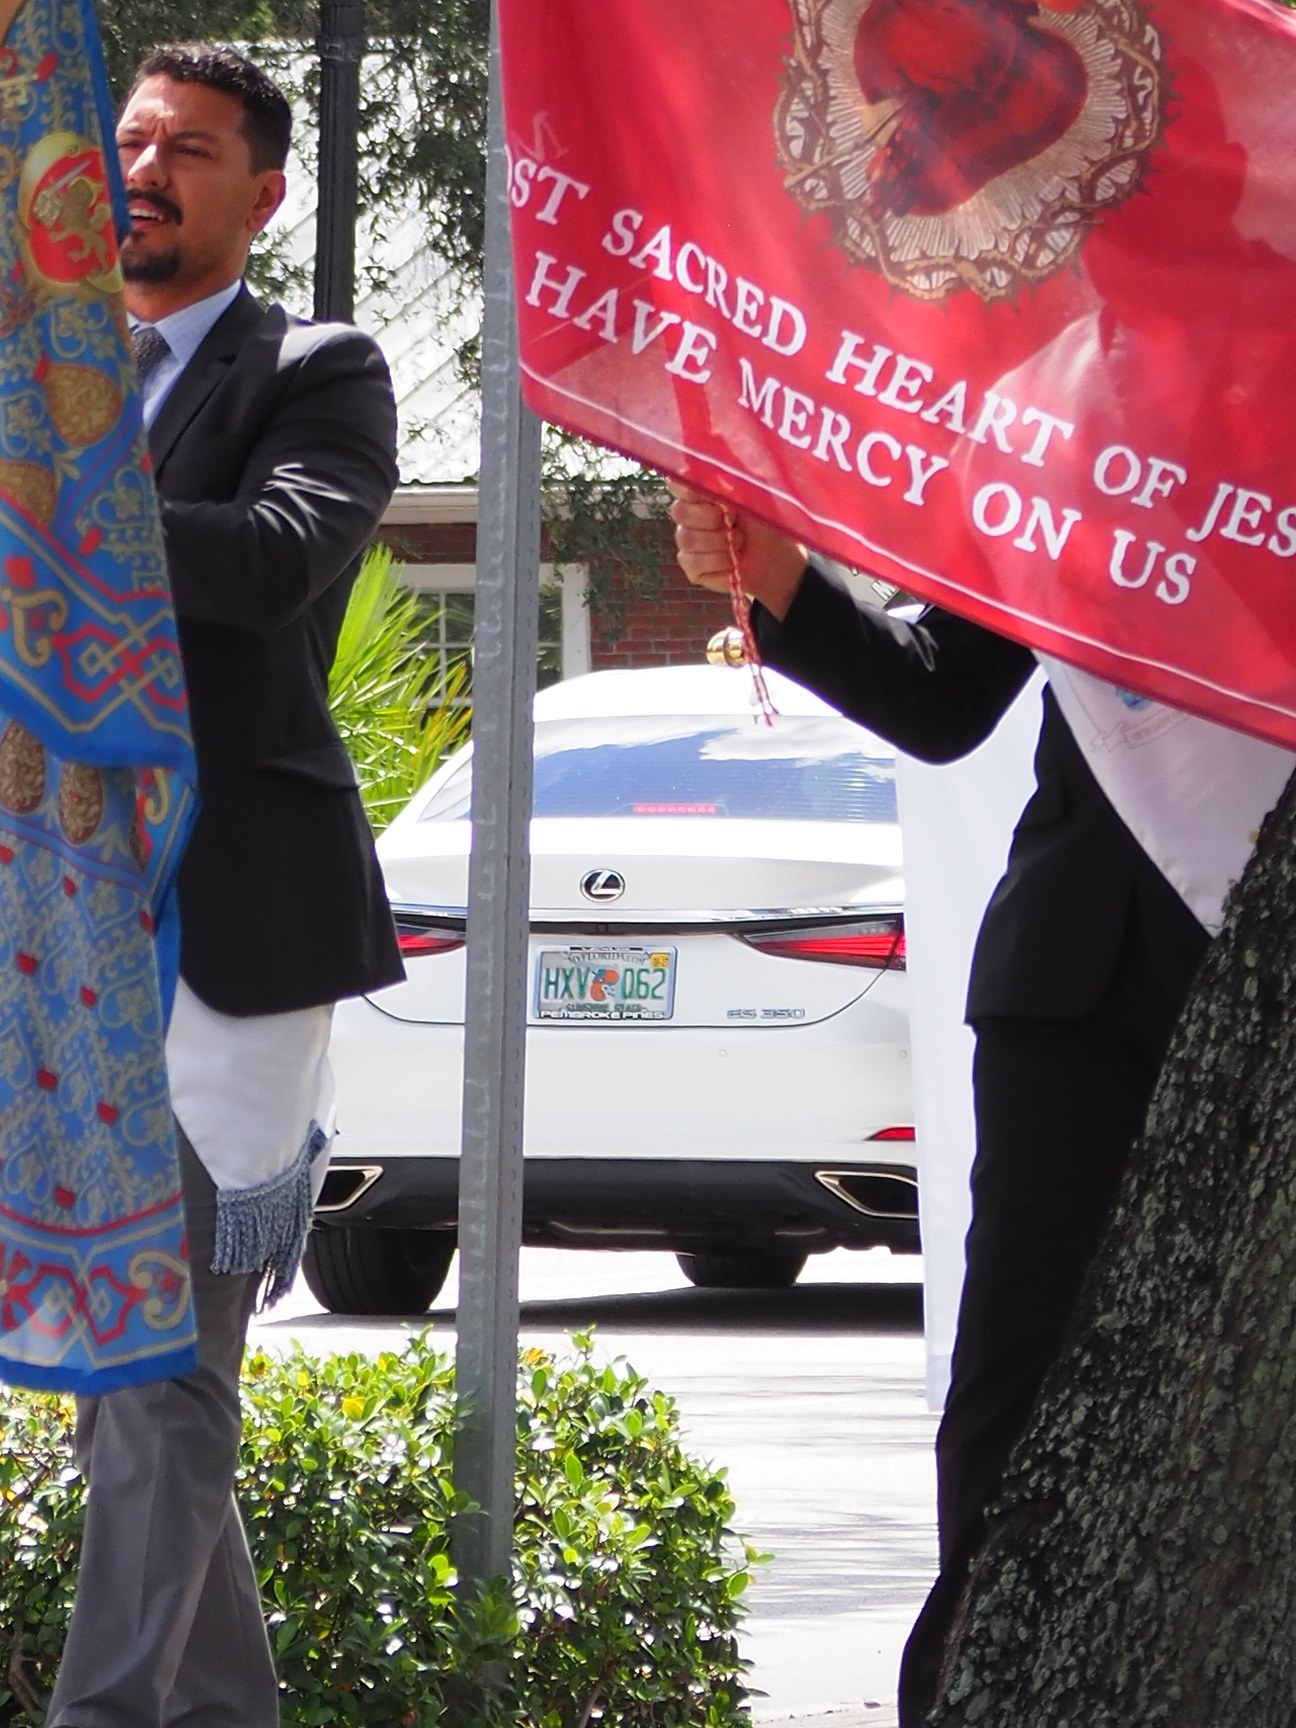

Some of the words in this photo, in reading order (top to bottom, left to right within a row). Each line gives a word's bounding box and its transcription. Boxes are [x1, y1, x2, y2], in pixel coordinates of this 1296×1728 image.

[503, 142, 591, 226] ST
[600, 208, 808, 357] SACRED
[824, 329, 1077, 468] HEART
[1092, 444, 1188, 509] OF
[524, 250, 718, 385] HAVE
[737, 356, 950, 507] MERCY
[971, 481, 1083, 561] ON
[1109, 528, 1197, 606] US
[543, 966, 591, 1000] HXV
[726, 1008, 758, 1020] ES
[760, 1008, 806, 1020] 350
